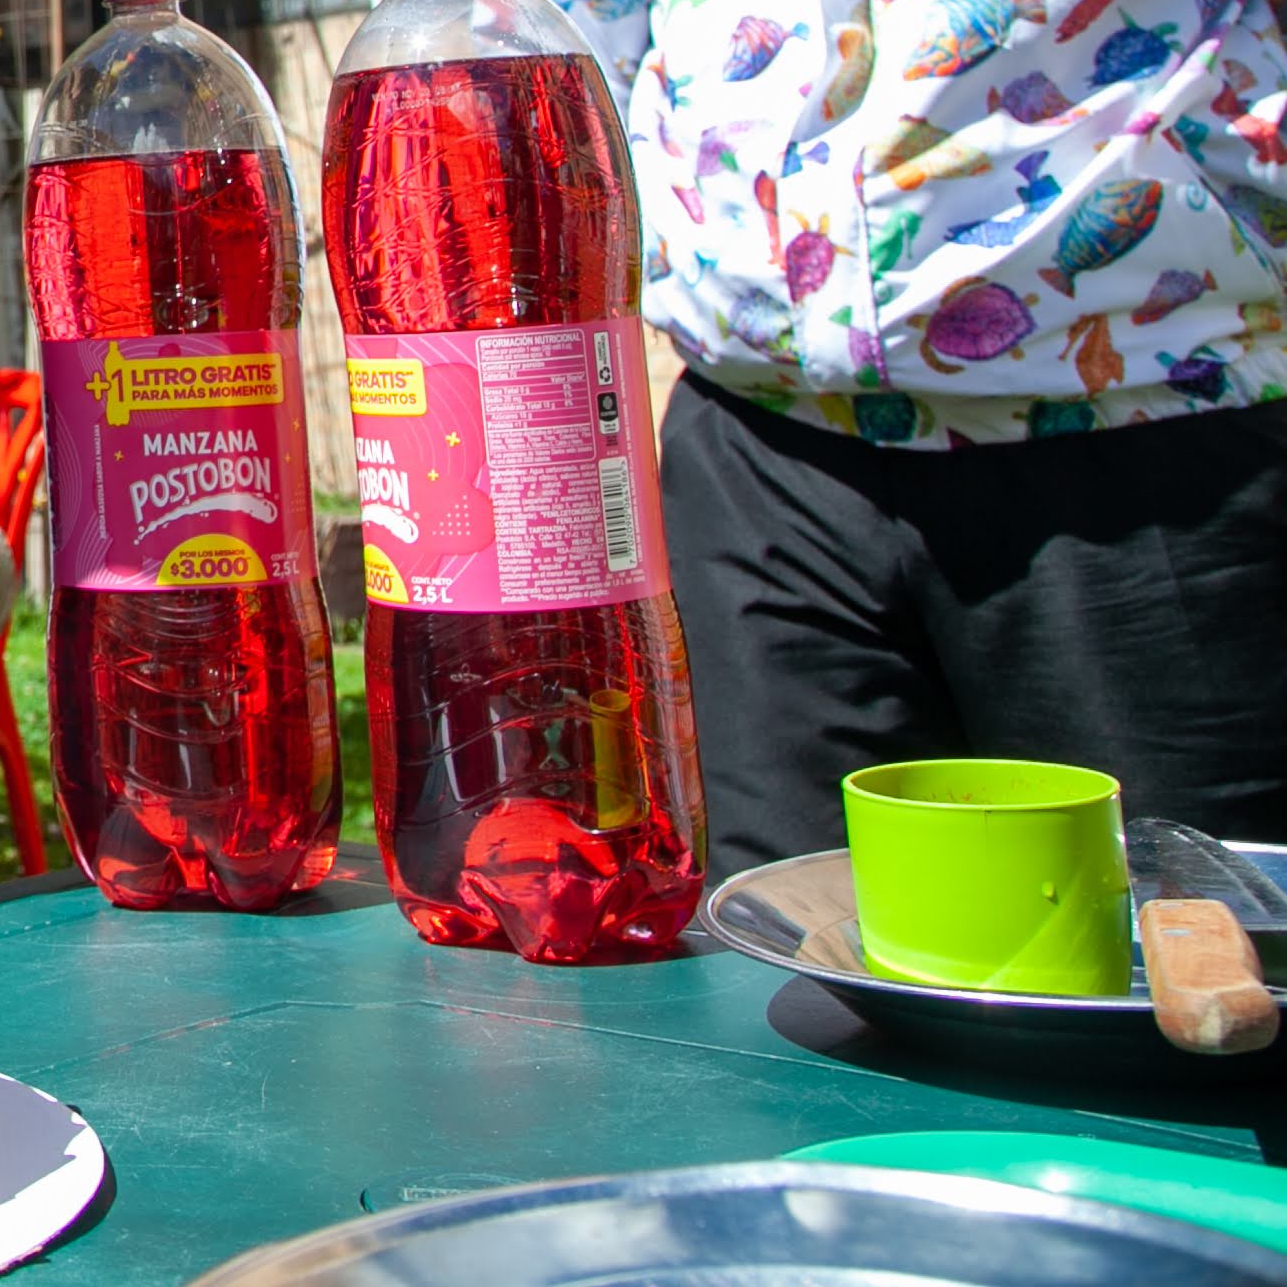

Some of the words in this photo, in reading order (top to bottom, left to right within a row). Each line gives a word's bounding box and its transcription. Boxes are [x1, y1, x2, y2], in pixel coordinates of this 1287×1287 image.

[480, 335, 533, 348] INFORMACIÓN
[535, 333, 581, 345] NUTRICIONAL
[482, 363, 509, 371] Cantidad
[131, 366, 197, 388] LITRO
[132, 390, 170, 401] PARA
[174, 386, 206, 399] MÁS
[209, 384, 278, 398] MOMENTOS
[360, 393, 417, 405] MOMENTOS
[143, 429, 258, 457] MANZANA
[356, 437, 395, 465] ZANA
[130, 458, 272, 524] POSTOBON
[413, 586, 437, 605] 2,5
[441, 587, 454, 604] L
